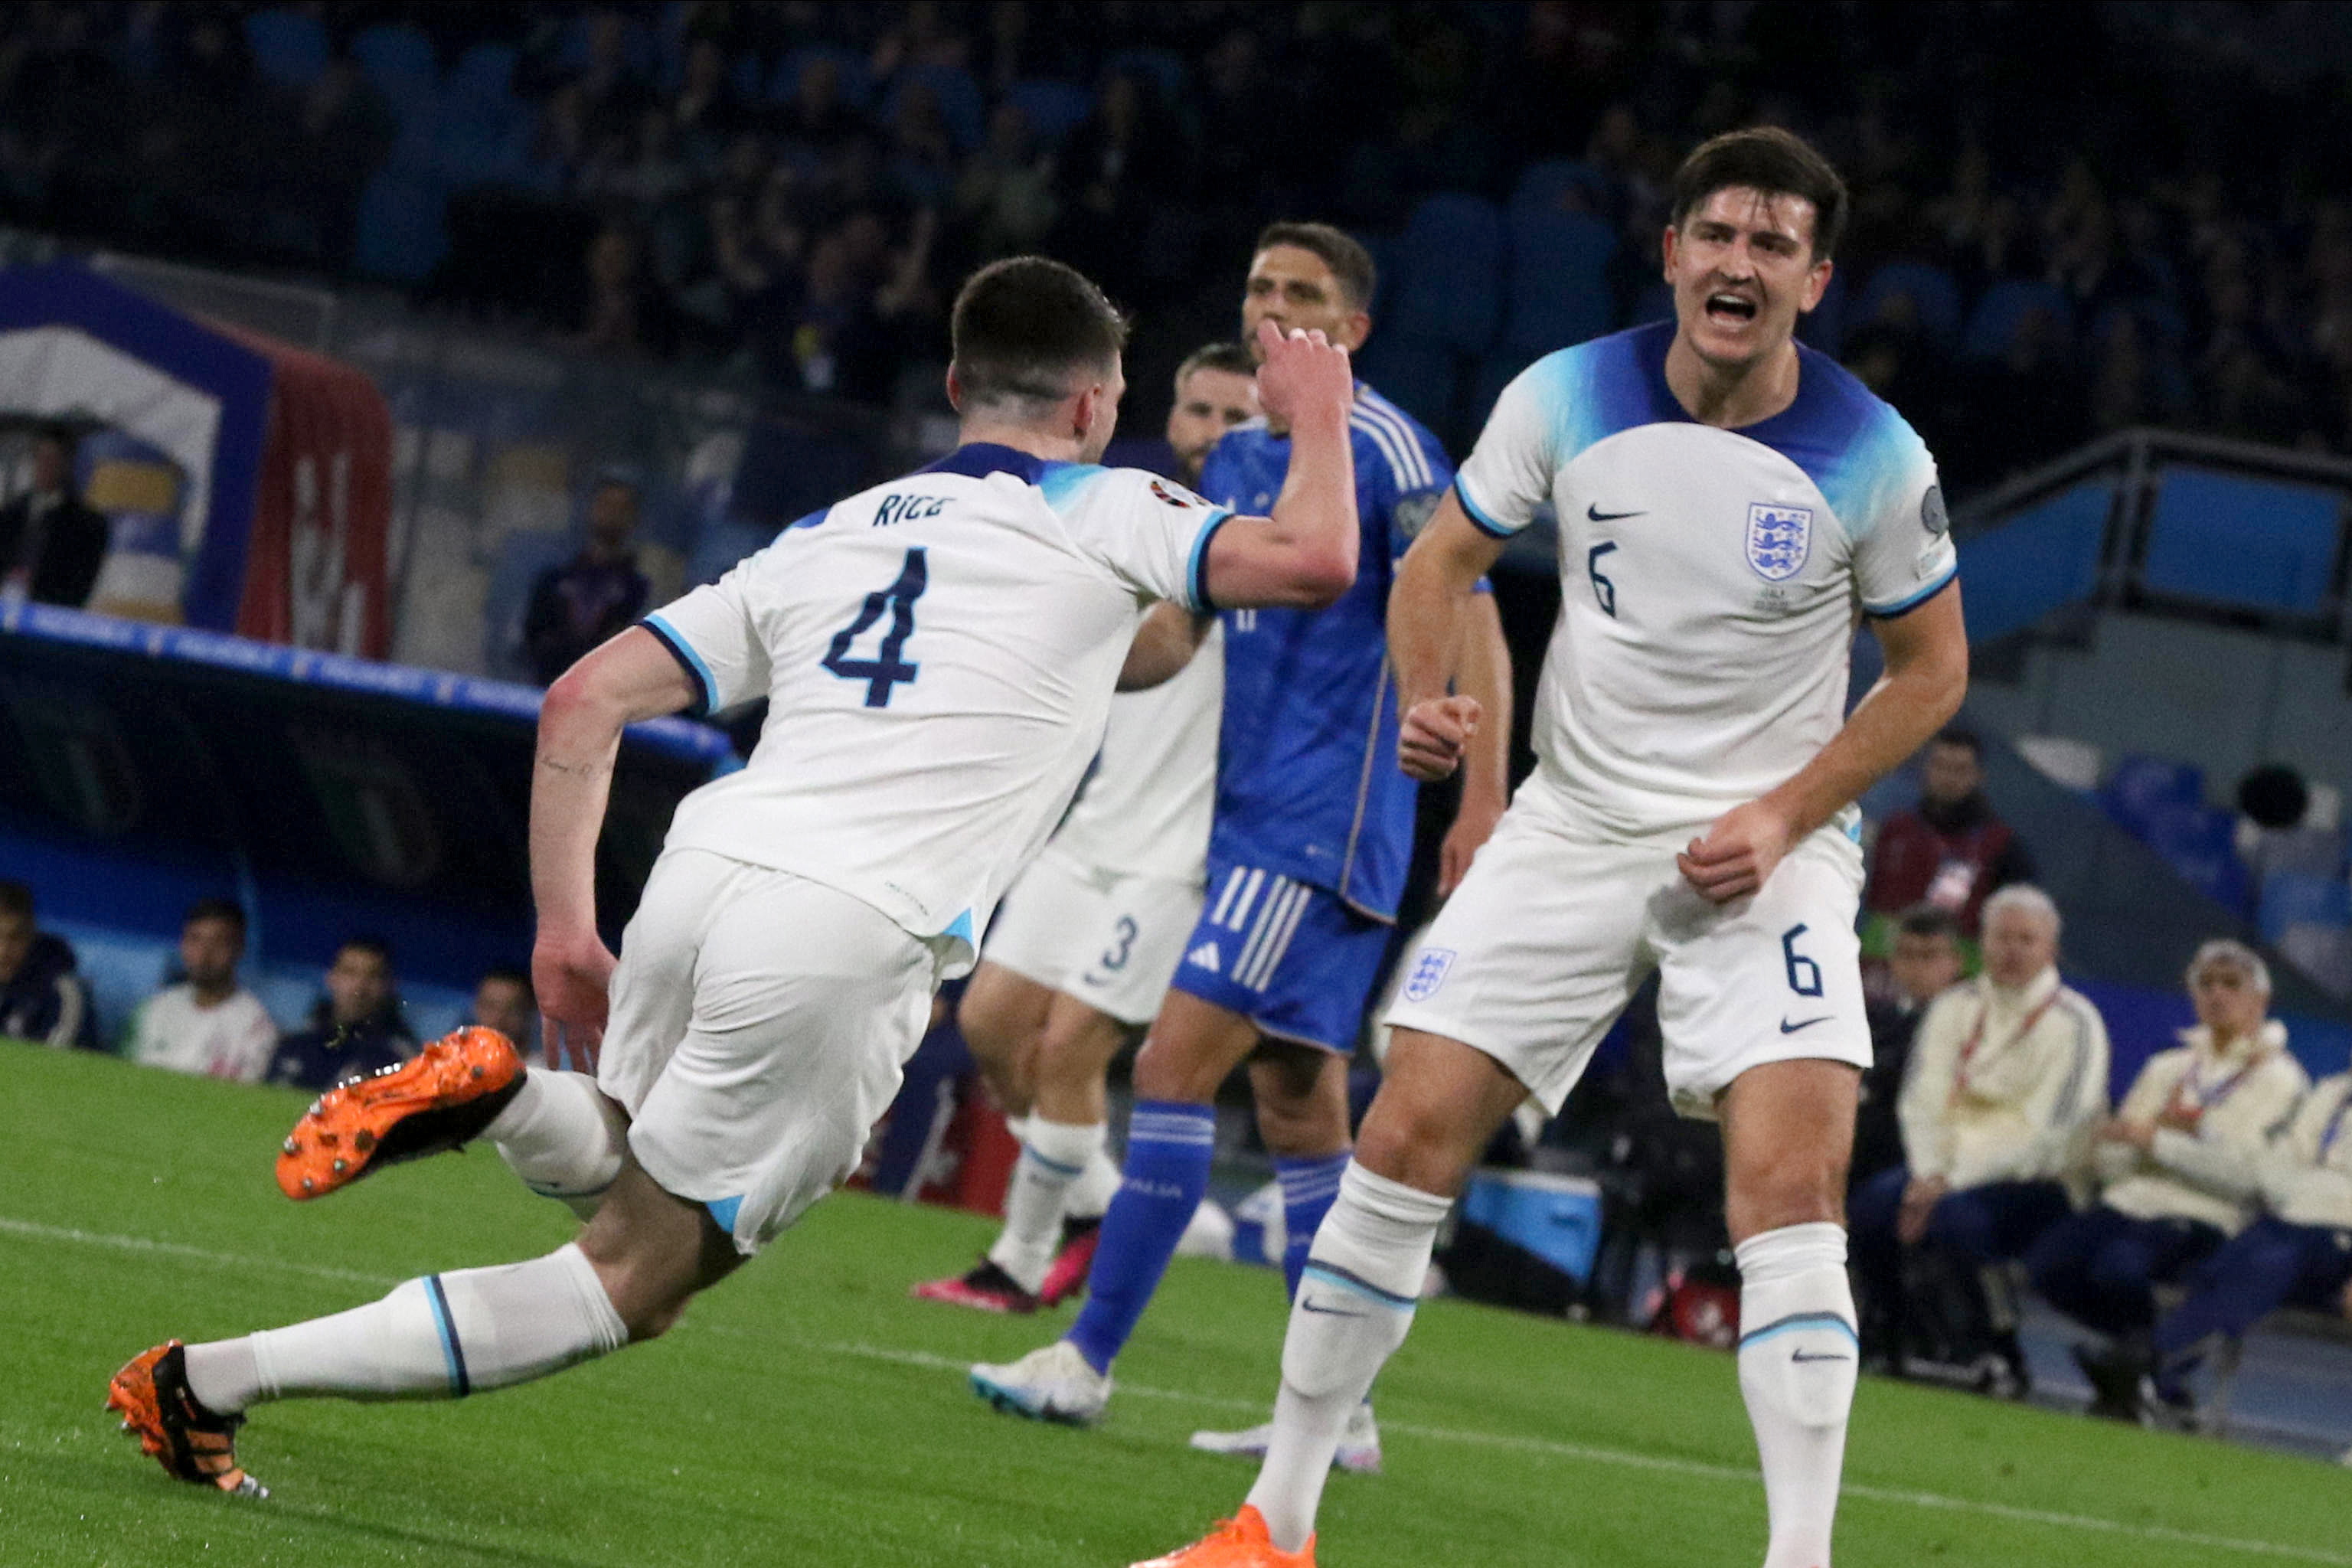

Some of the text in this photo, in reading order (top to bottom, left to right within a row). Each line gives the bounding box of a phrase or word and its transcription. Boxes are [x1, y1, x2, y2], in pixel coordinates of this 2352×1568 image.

[872, 495, 956, 526] RICE
[1588, 541, 1618, 618] 6
[819, 547, 926, 707] 4
[1100, 915, 1138, 970] 3
[1782, 923, 1823, 997] 6
